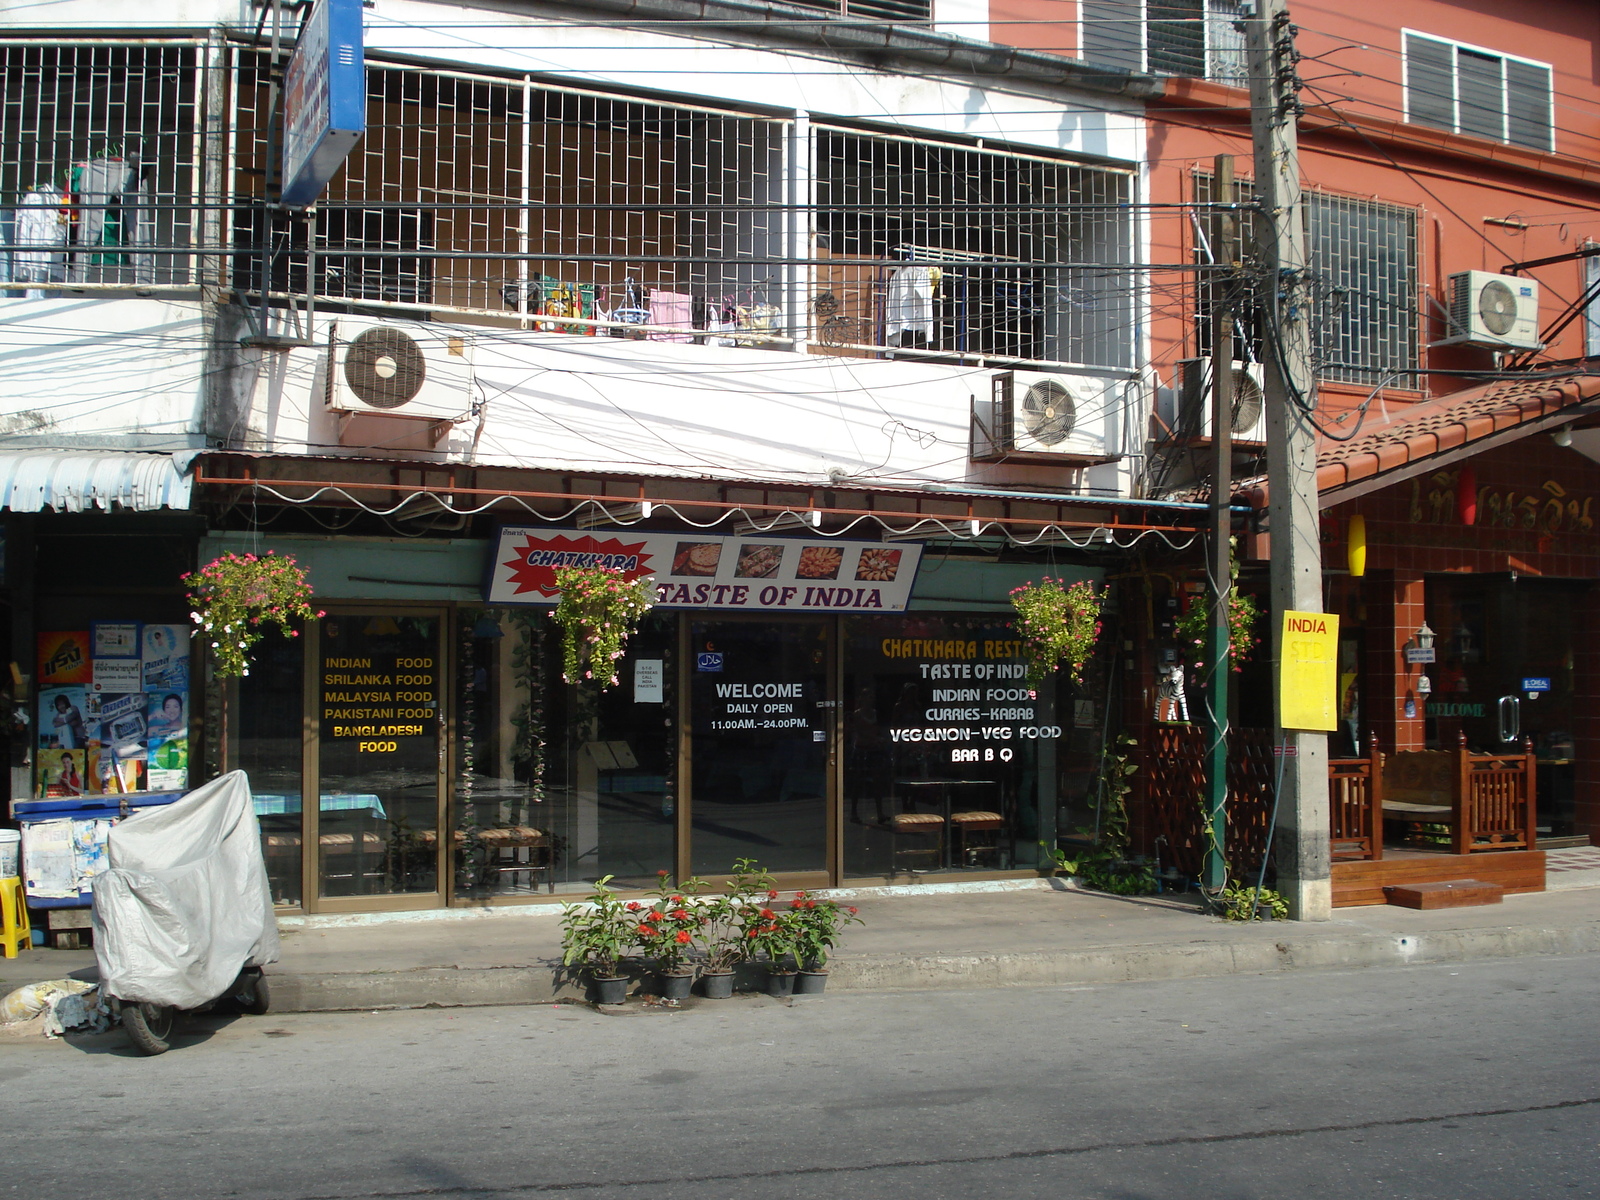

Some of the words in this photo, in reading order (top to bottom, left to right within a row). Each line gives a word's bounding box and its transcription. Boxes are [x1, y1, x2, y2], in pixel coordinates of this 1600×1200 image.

[527, 550, 638, 571] CHATKHARA
[656, 583, 747, 605] TASTE
[759, 585, 798, 606] OF
[802, 586, 884, 608] INDIA
[1288, 618, 1327, 634] INDIA
[882, 638, 977, 660] CHATKHARA
[1291, 641, 1322, 658] STD
[326, 658, 371, 668] INDIAN
[396, 658, 433, 668] FOOD
[701, 654, 721, 666] حلال
[920, 664, 972, 680] TASTE
[974, 664, 994, 680] OF
[325, 675, 391, 685] SRILANKA
[396, 675, 432, 685] FOOD
[325, 692, 391, 702] MALAYSIA
[396, 692, 432, 702] FOOD
[716, 684, 803, 698] WELCOME
[933, 689, 980, 702] INDIAN
[987, 689, 1029, 701] FOOD
[325, 709, 393, 719] PAKISTANI
[397, 709, 433, 718] FOOD
[727, 704, 759, 713] DAILY
[763, 704, 793, 713] OPEN
[1426, 703, 1486, 718] WELCOME
[333, 725, 423, 736] BANGLADESH
[1019, 726, 1062, 739] FOOD
[360, 741, 397, 752] FOOD
[952, 749, 979, 762] BAR
[984, 748, 994, 761] B
[1000, 748, 1013, 762] Q
